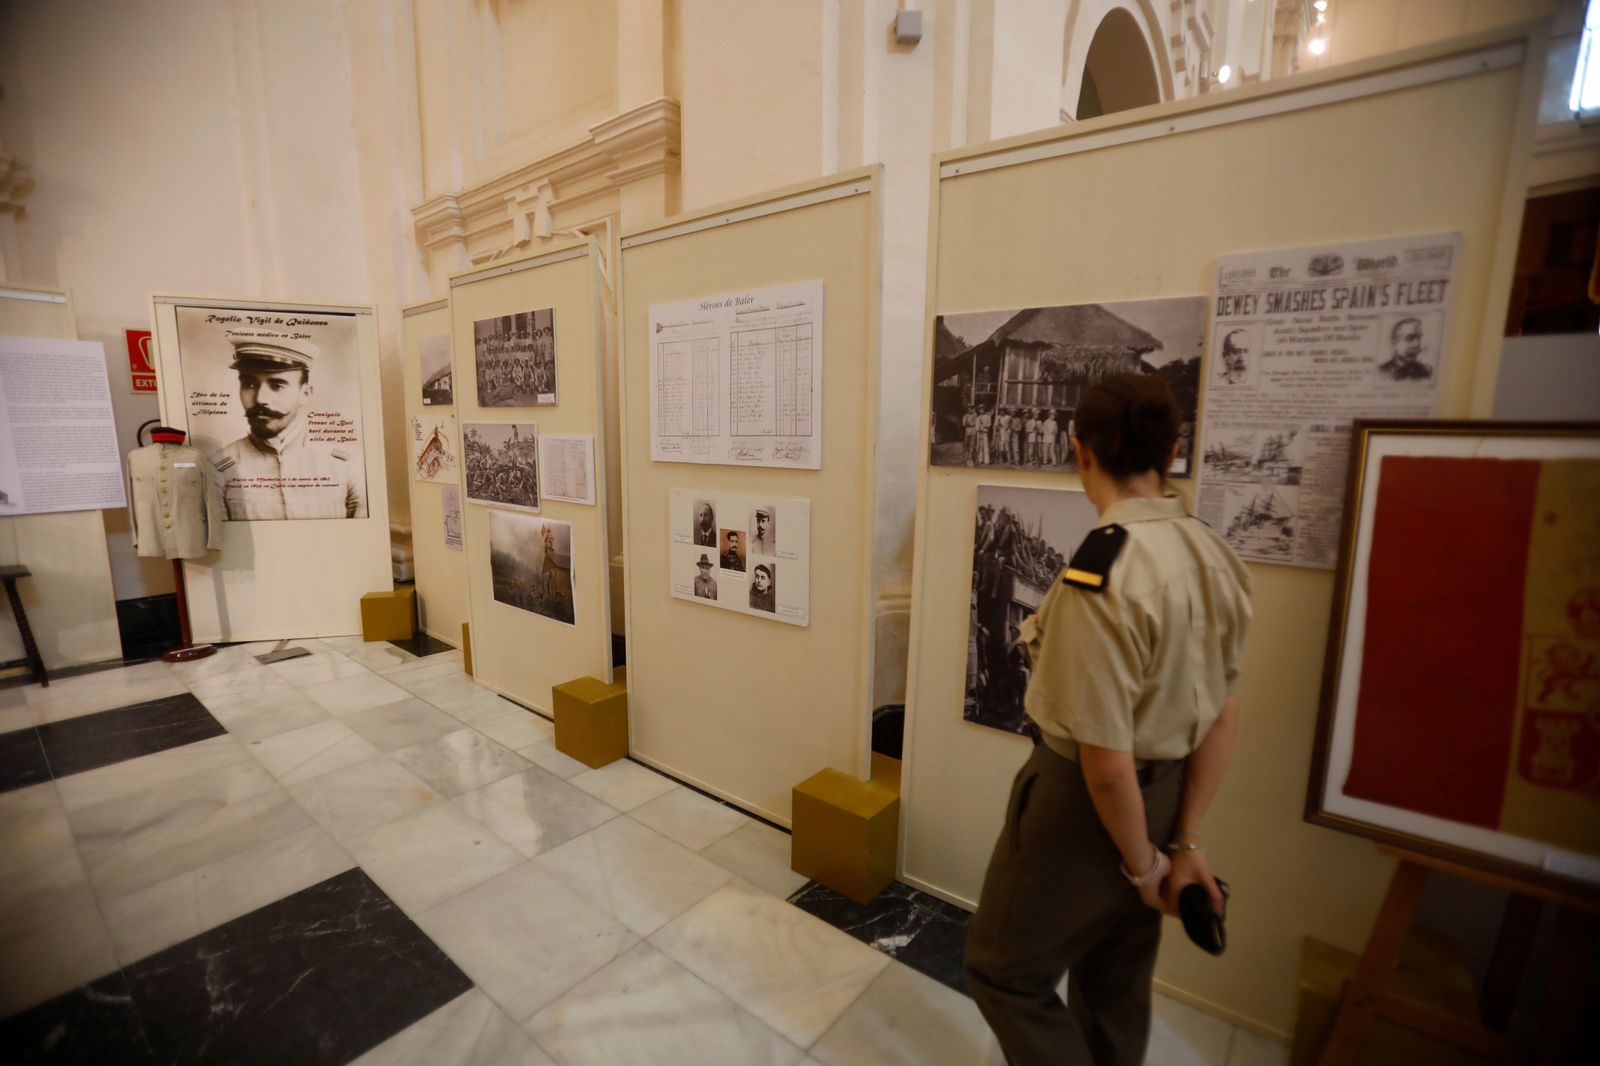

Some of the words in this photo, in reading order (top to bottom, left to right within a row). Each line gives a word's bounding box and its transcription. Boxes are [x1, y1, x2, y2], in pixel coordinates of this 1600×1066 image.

[724, 297, 733, 307] de
[735, 295, 754, 305] Baler
[1216, 293, 1260, 317] DEWEY
[1265, 288, 1328, 314] SMASHES
[1331, 283, 1392, 311] SPAIN'S
[1398, 279, 1450, 305] FLEET
[205, 314, 242, 324] Rogelio
[245, 316, 272, 325] Vigil
[286, 318, 328, 327] Quiñones
[224, 330, 255, 338] Teniente
